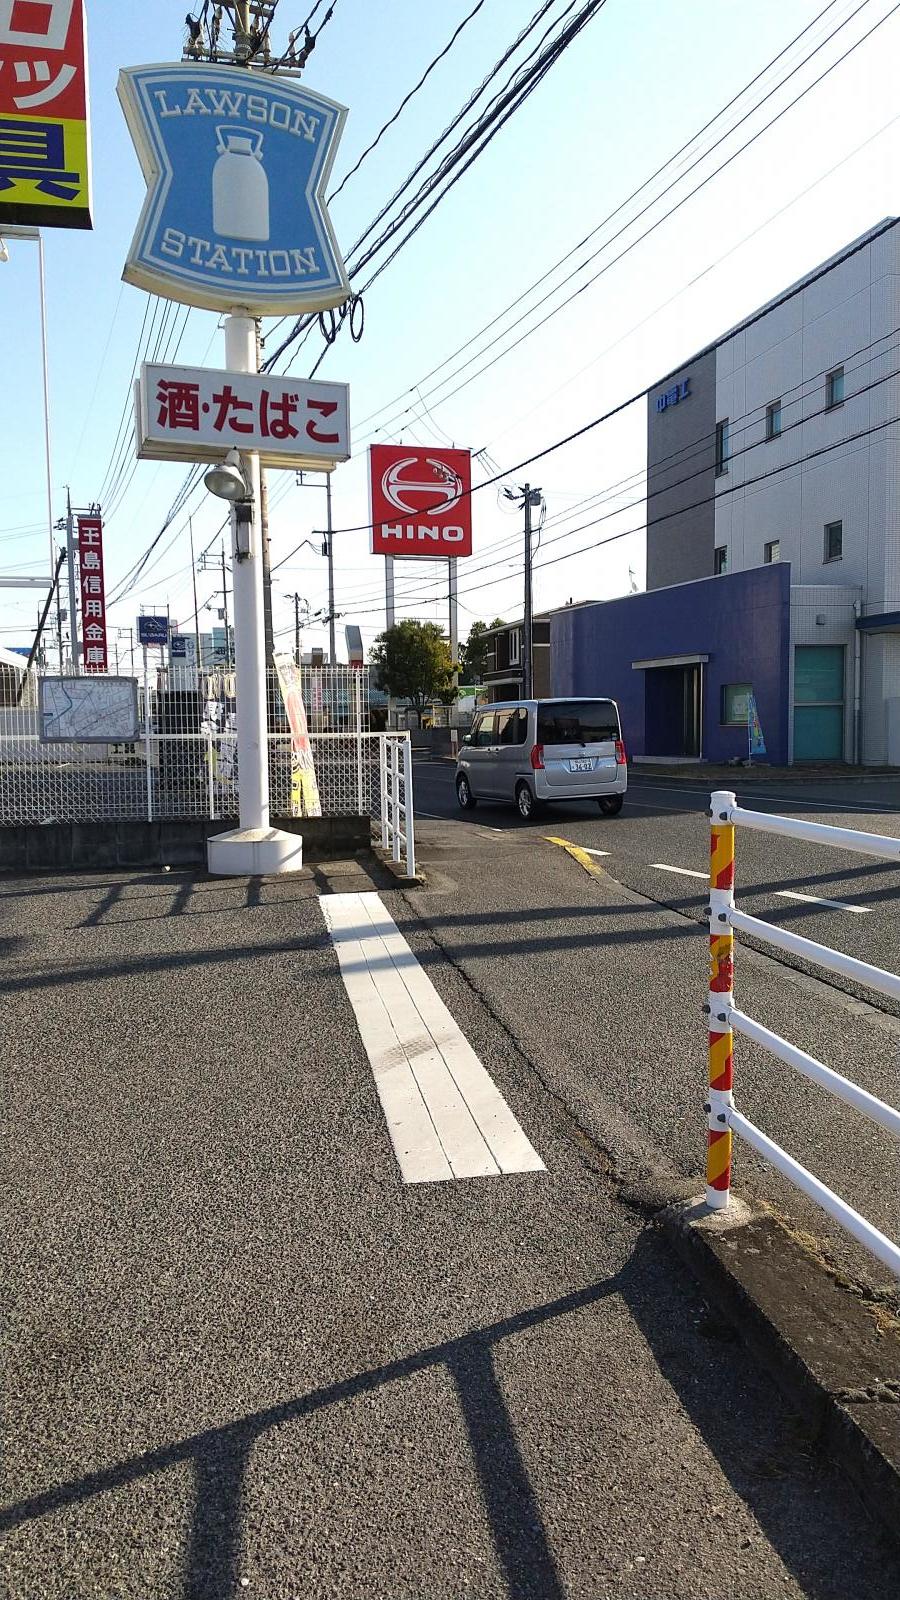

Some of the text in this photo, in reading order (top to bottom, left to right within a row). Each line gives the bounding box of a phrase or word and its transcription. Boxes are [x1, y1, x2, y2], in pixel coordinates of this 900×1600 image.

[154, 88, 320, 143] LAWSON
[160, 227, 320, 277] STATION
[381, 524, 464, 542] HINO
[81, 526, 105, 664] 玉島信用金庫
